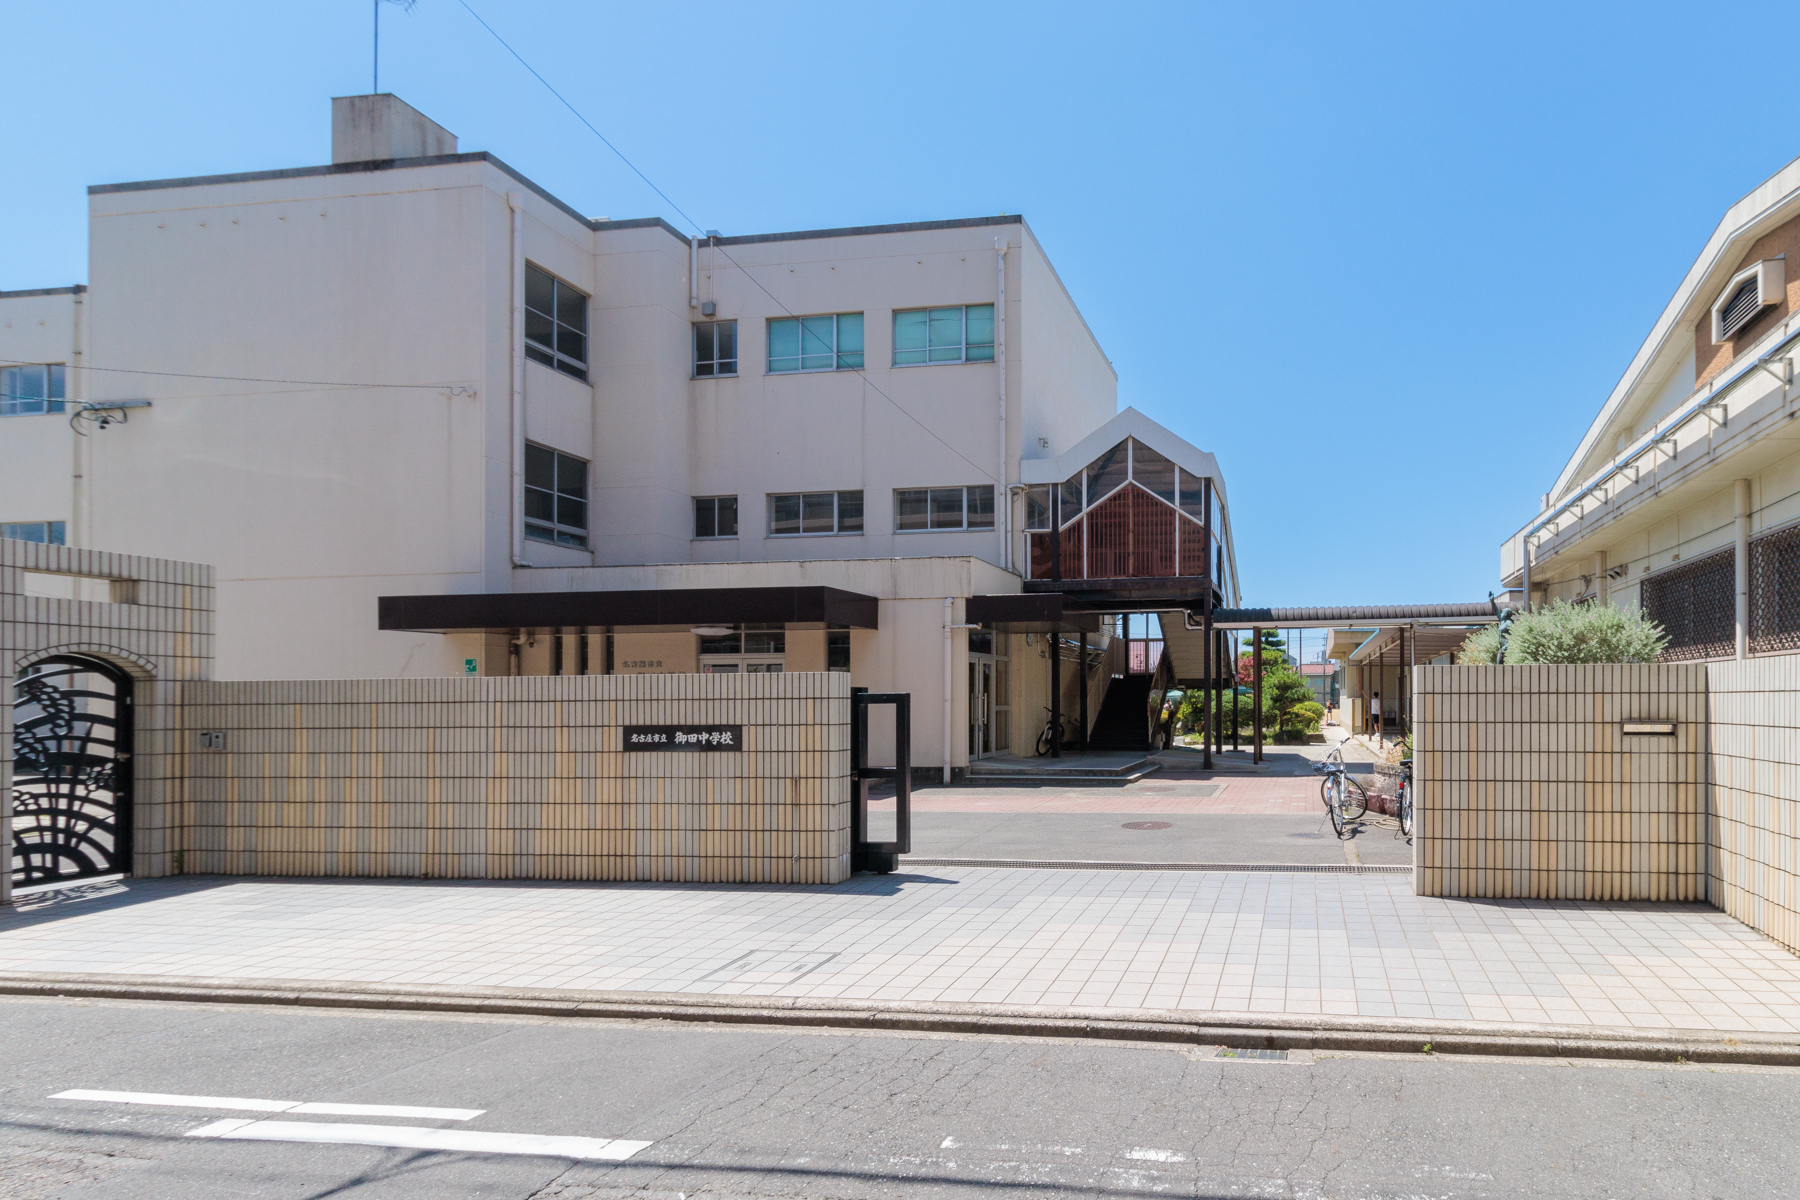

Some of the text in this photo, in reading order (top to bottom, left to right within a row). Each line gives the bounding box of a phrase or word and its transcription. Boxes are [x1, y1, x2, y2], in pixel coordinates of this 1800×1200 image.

[630, 731, 734, 745] 名古屋市立 御田中学校
